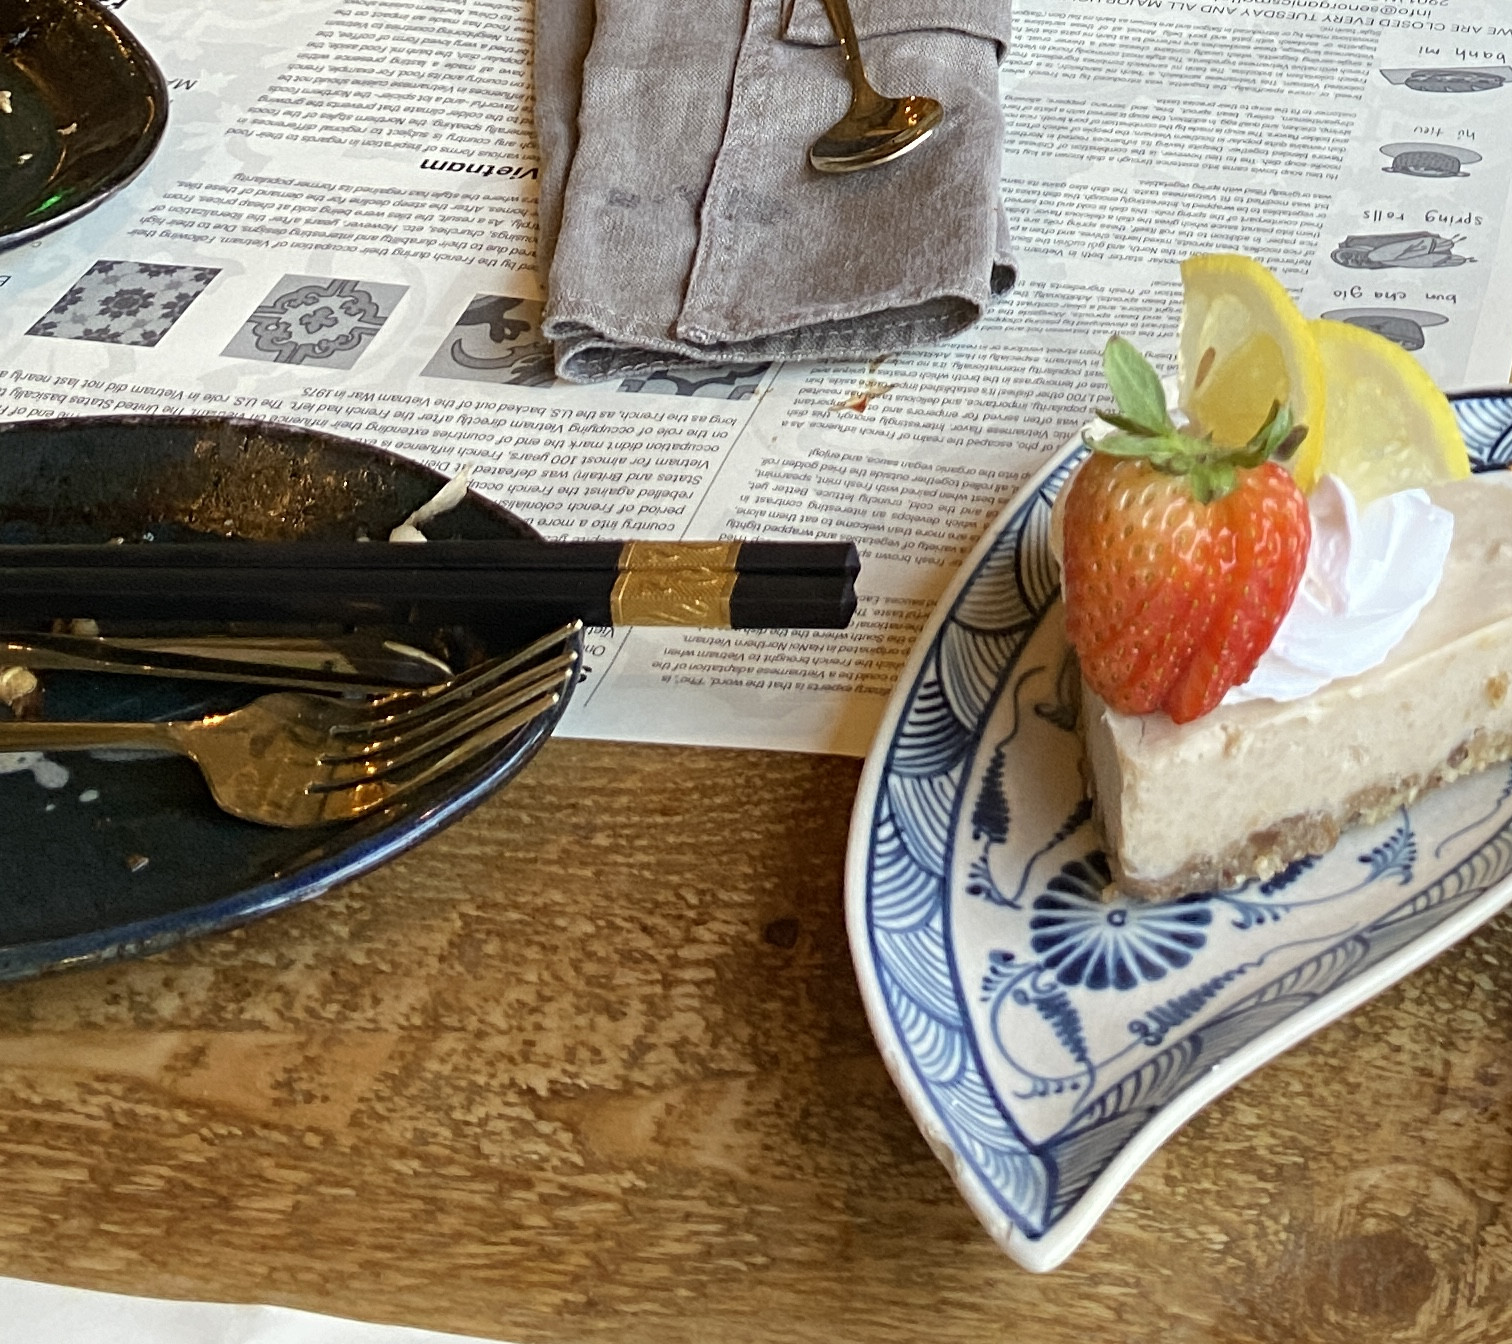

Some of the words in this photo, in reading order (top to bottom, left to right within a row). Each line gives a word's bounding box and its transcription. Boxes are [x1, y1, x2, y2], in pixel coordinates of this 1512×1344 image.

[1166, 0, 1198, 12] ALL
[1199, 3, 1239, 16] AND
[1238, 6, 1318, 23] TUESDAY
[1320, 12, 1376, 27] EVERY
[1377, 17, 1447, 32] CLOSED
[1449, 22, 1484, 35] ARE
[418, 157, 541, 181] Vietnam
[1361, 208, 1405, 224] rolls
[1423, 208, 1484, 227] spring
